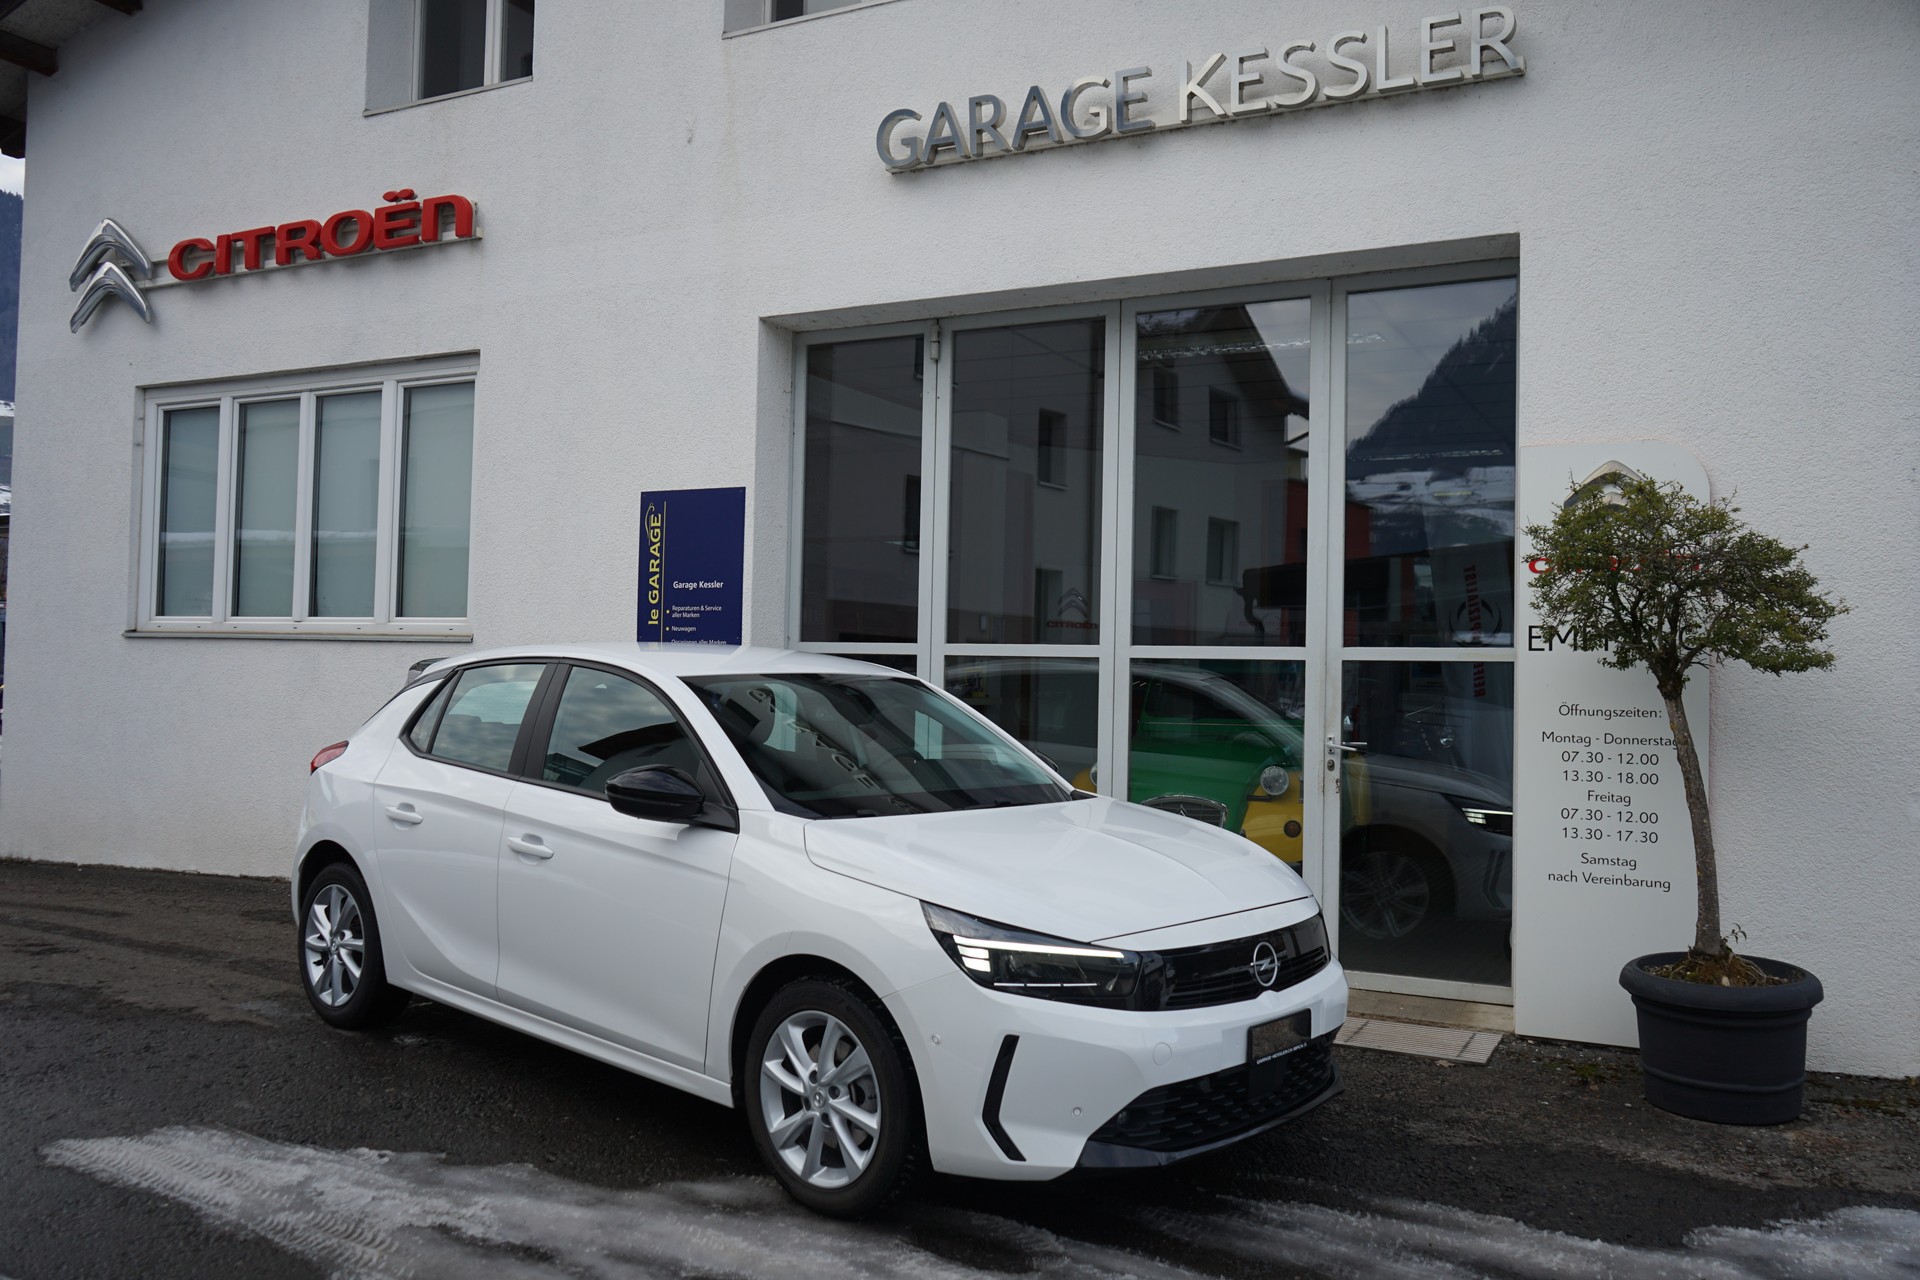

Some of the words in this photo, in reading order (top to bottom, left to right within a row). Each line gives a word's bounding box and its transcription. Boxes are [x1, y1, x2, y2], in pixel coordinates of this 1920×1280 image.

[876, 66, 1155, 170] GARAGE
[1179, 6, 1523, 124] KESSLER
[648, 513, 662, 604] GARAGE
[673, 581, 698, 591] Garage
[699, 581, 724, 589] Kessler
[648, 609, 659, 625] le
[1558, 701, 1662, 720] Öffnungszeiten:
[1541, 731, 1592, 747] Montag
[1561, 751, 1604, 763] 07.30
[1617, 753, 1659, 765] 12.00
[1563, 770, 1604, 783] 13.30
[1617, 773, 1659, 785] 18.00
[1587, 790, 1632, 807] Freitag
[1561, 808, 1603, 821] 07.30
[1616, 811, 1658, 824] 12.00
[1562, 828, 1603, 840] 13.30
[1616, 830, 1658, 843] 17.30
[1581, 853, 1637, 870] Samstag
[1548, 870, 1578, 883] nach
[1582, 872, 1671, 892] Vereinbarung
